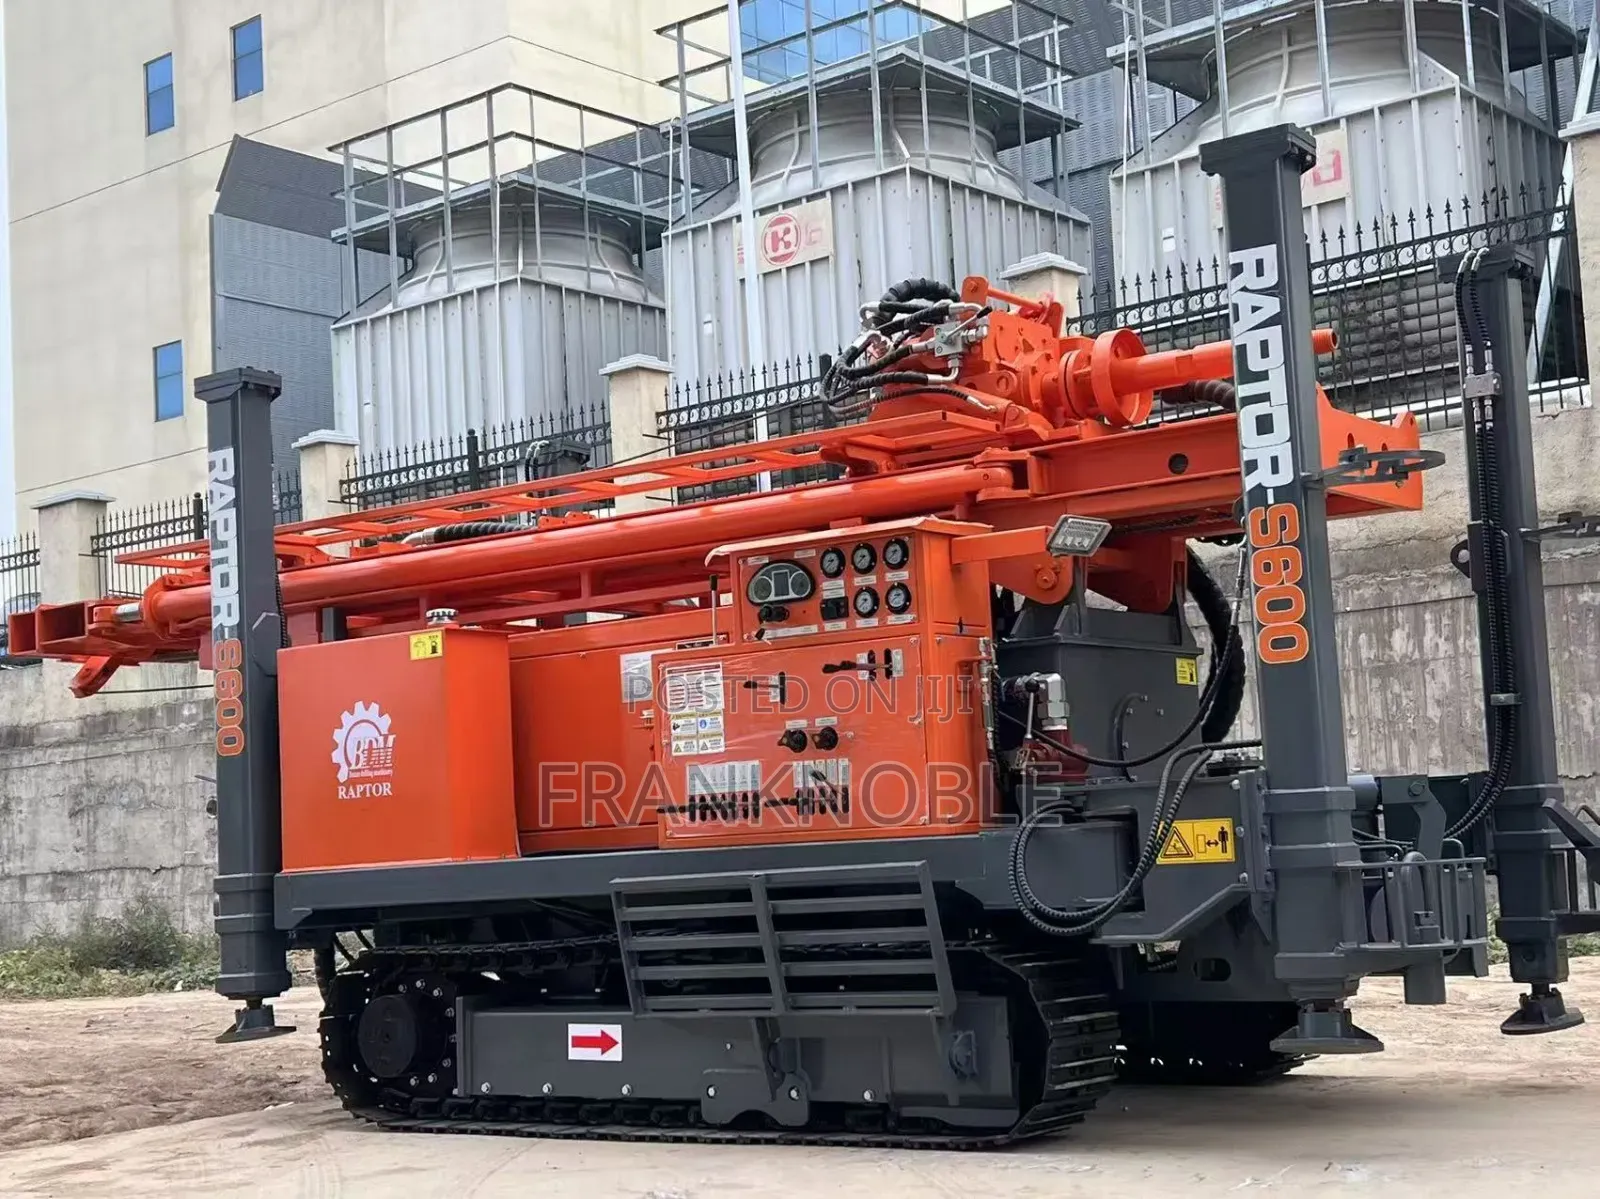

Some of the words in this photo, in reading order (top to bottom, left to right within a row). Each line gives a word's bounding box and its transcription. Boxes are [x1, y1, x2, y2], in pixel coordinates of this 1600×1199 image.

[208, 447, 244, 756] RAPTOR-S600
[1229, 244, 1309, 663] RAPTOR-S600
[338, 782, 393, 799] RAPTOR
